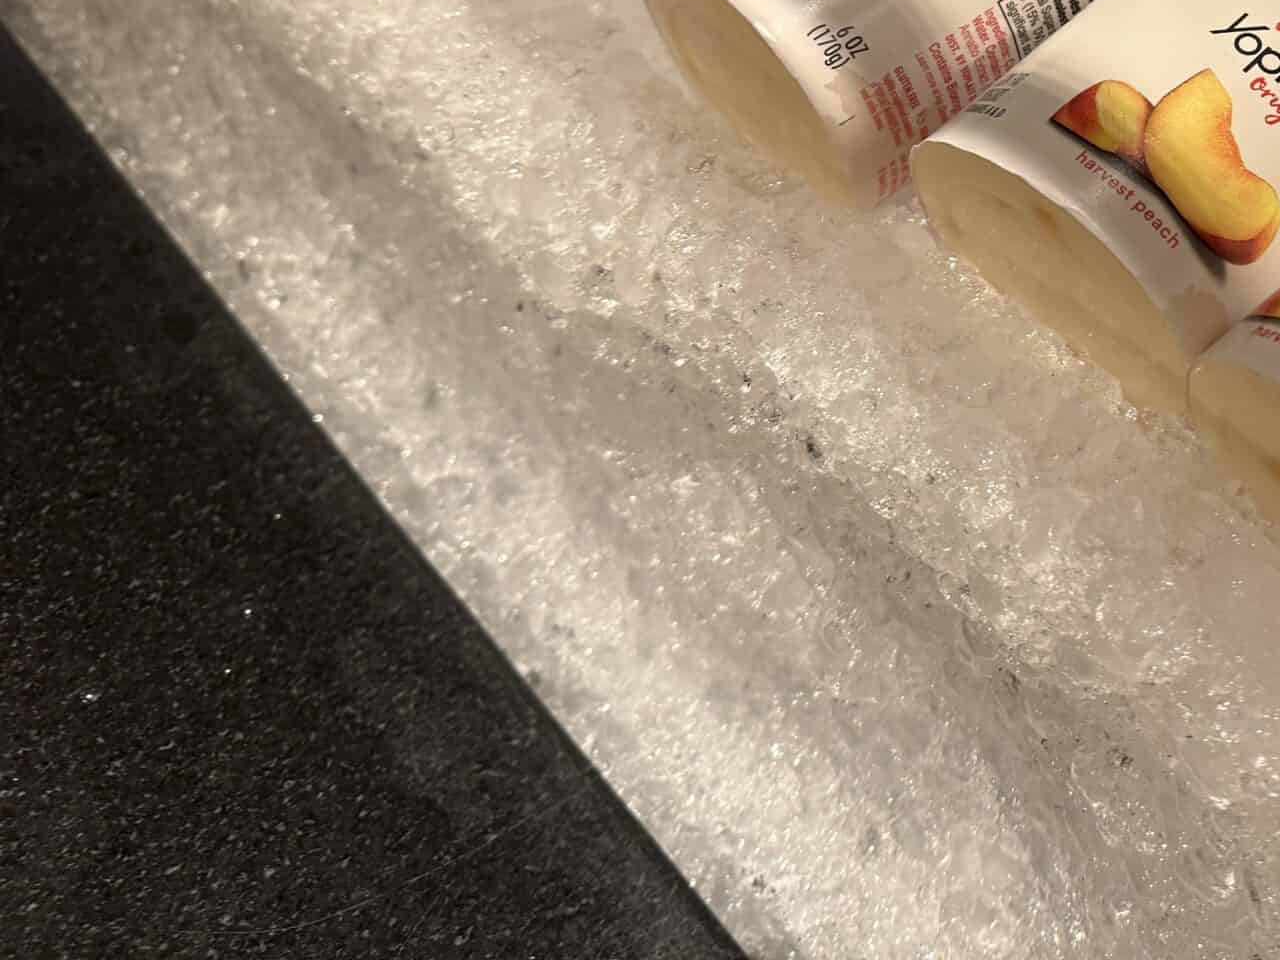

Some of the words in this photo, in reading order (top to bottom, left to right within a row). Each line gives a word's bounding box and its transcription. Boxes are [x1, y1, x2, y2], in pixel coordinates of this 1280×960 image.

[806, 23, 852, 71] (170g)
[844, 35, 870, 60] OZ
[1074, 150, 1139, 209] harvest
[1130, 198, 1181, 250] peach
